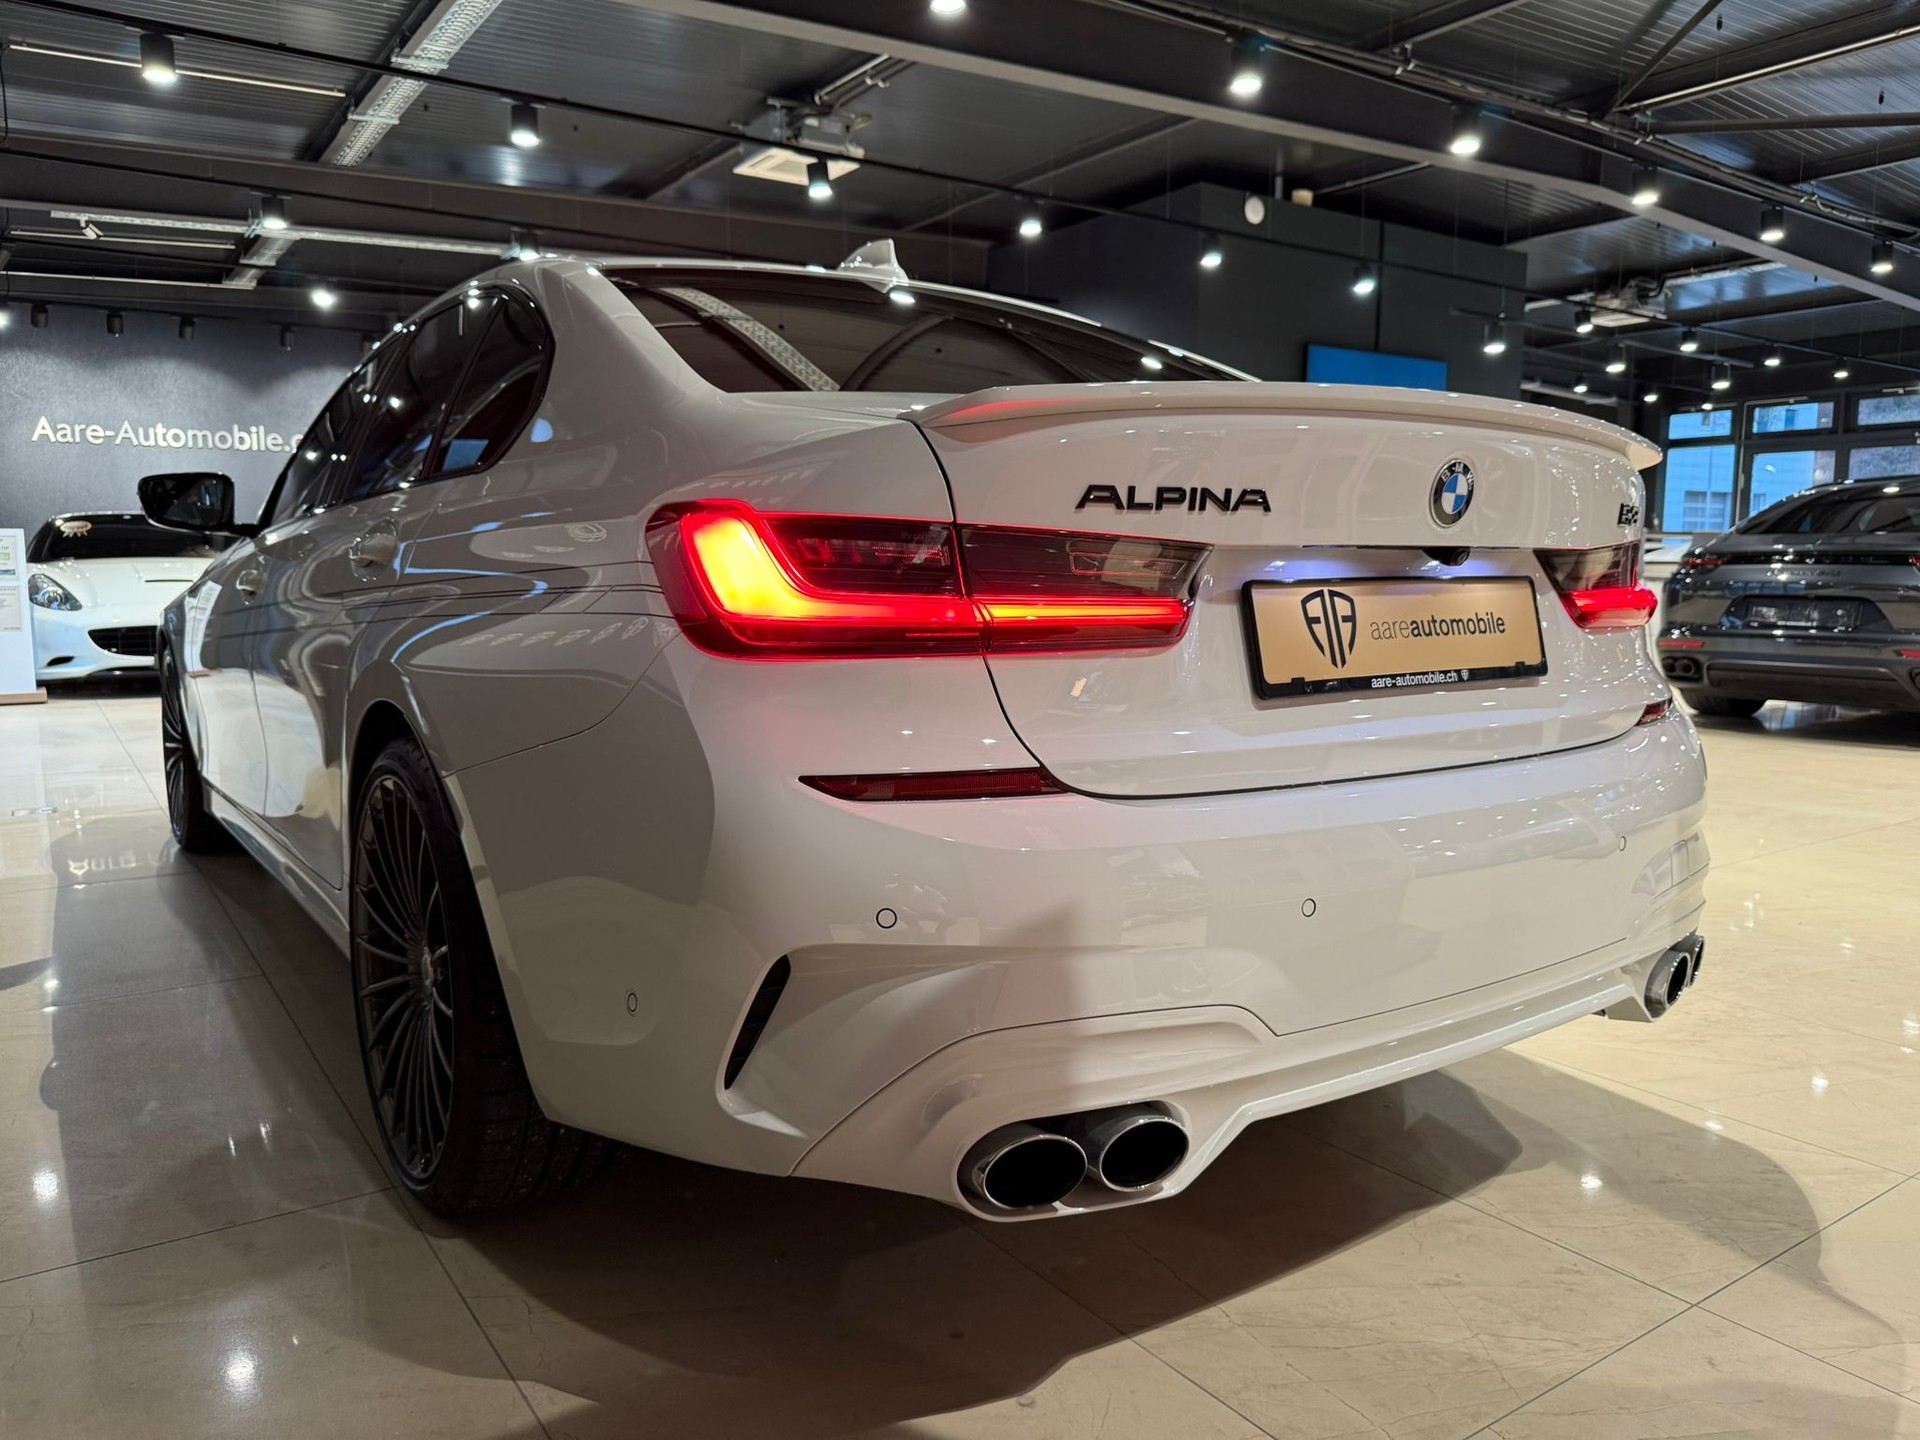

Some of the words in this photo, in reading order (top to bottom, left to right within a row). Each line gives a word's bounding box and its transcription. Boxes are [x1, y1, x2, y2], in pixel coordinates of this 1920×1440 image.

[1441, 462, 1475, 491] BMW
[1075, 484, 1271, 513] ALPINA
[1370, 612, 1505, 641] aareautomobile
[1371, 670, 1458, 688] aare-automobile.ch
